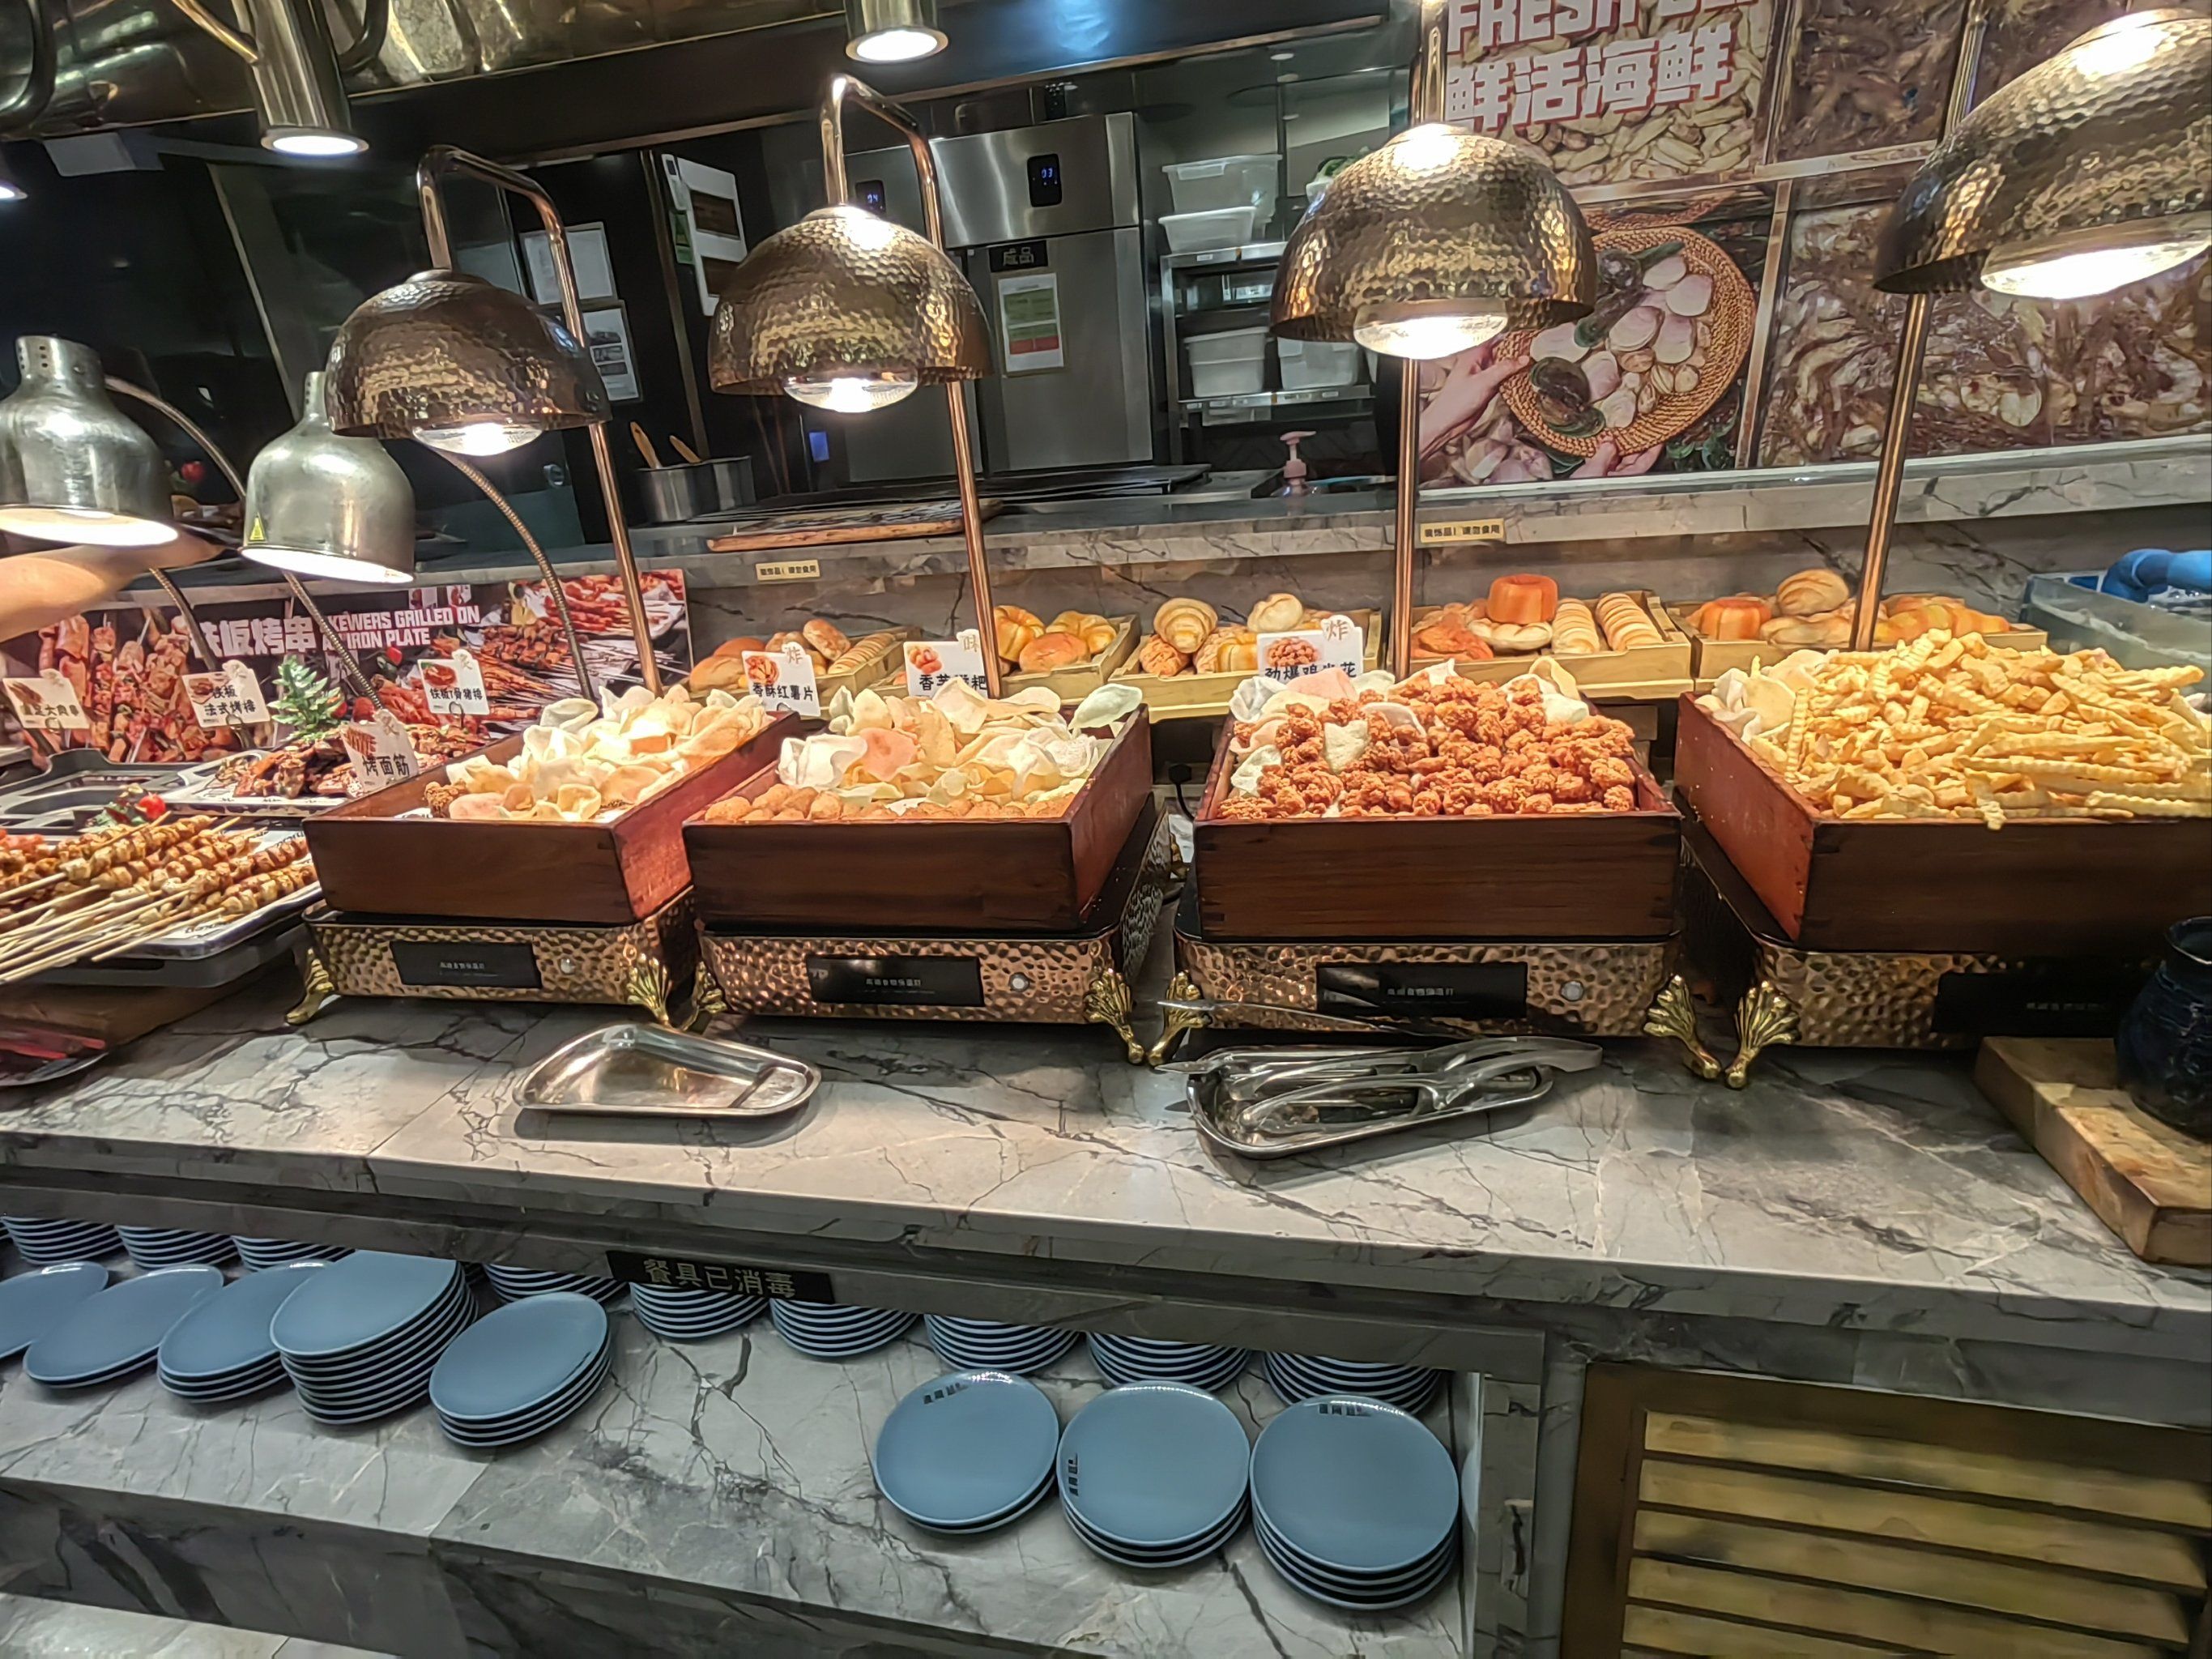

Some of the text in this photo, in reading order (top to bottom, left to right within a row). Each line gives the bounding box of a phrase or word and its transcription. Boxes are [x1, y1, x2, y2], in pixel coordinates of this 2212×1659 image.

[1445, 23, 1733, 132] 鲜活海鲜
[320, 606, 479, 633] KEWERS GRILLED ON
[1326, 619, 1349, 642] 炸
[347, 630, 383, 650] IRON
[386, 627, 431, 647] PLATE
[362, 753, 410, 778] 烤面筋
[643, 1259, 796, 1298] 餐具已消毒
